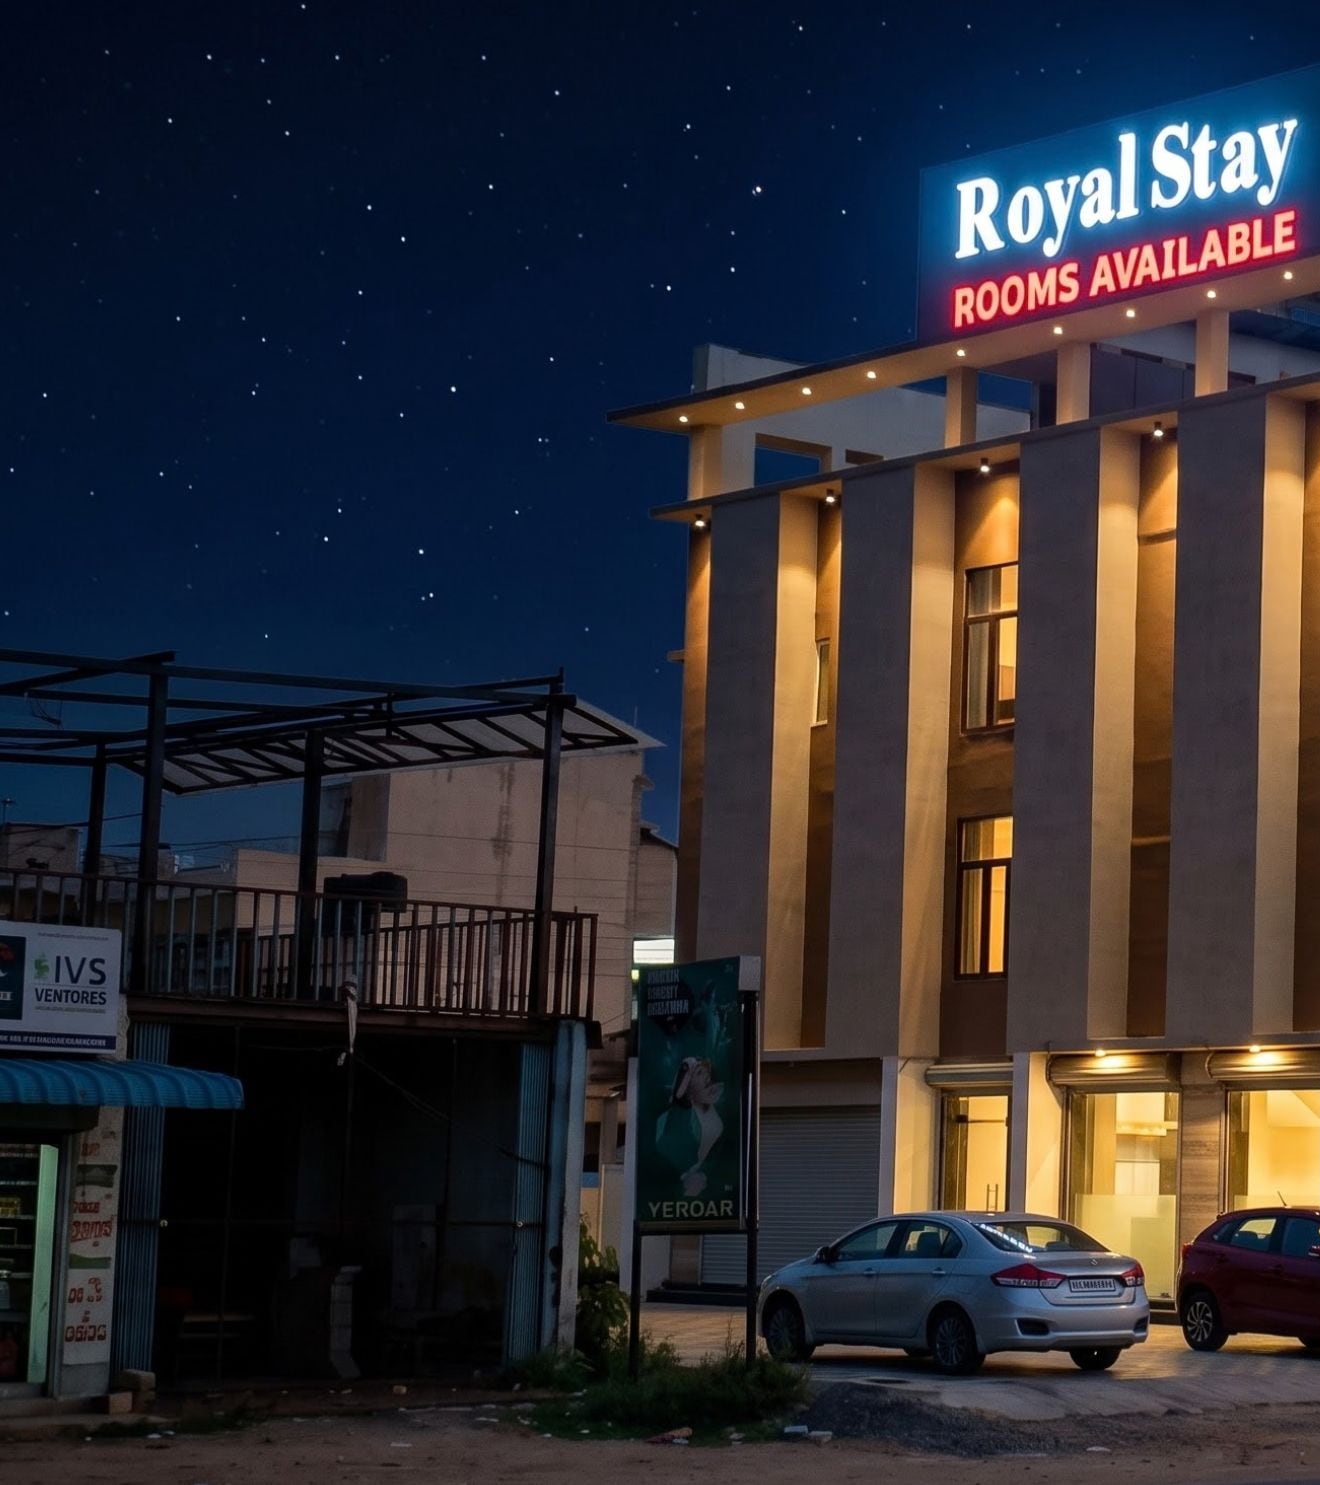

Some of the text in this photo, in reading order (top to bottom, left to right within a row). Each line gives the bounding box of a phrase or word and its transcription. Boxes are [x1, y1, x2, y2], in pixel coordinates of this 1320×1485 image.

[954, 119, 1298, 259] Royal Stay
[954, 210, 1297, 328] ROOMS AVAILABLE
[54, 955, 107, 985] IVS
[35, 987, 107, 1005] VENTORES
[648, 1199, 734, 1218] YEROAR
